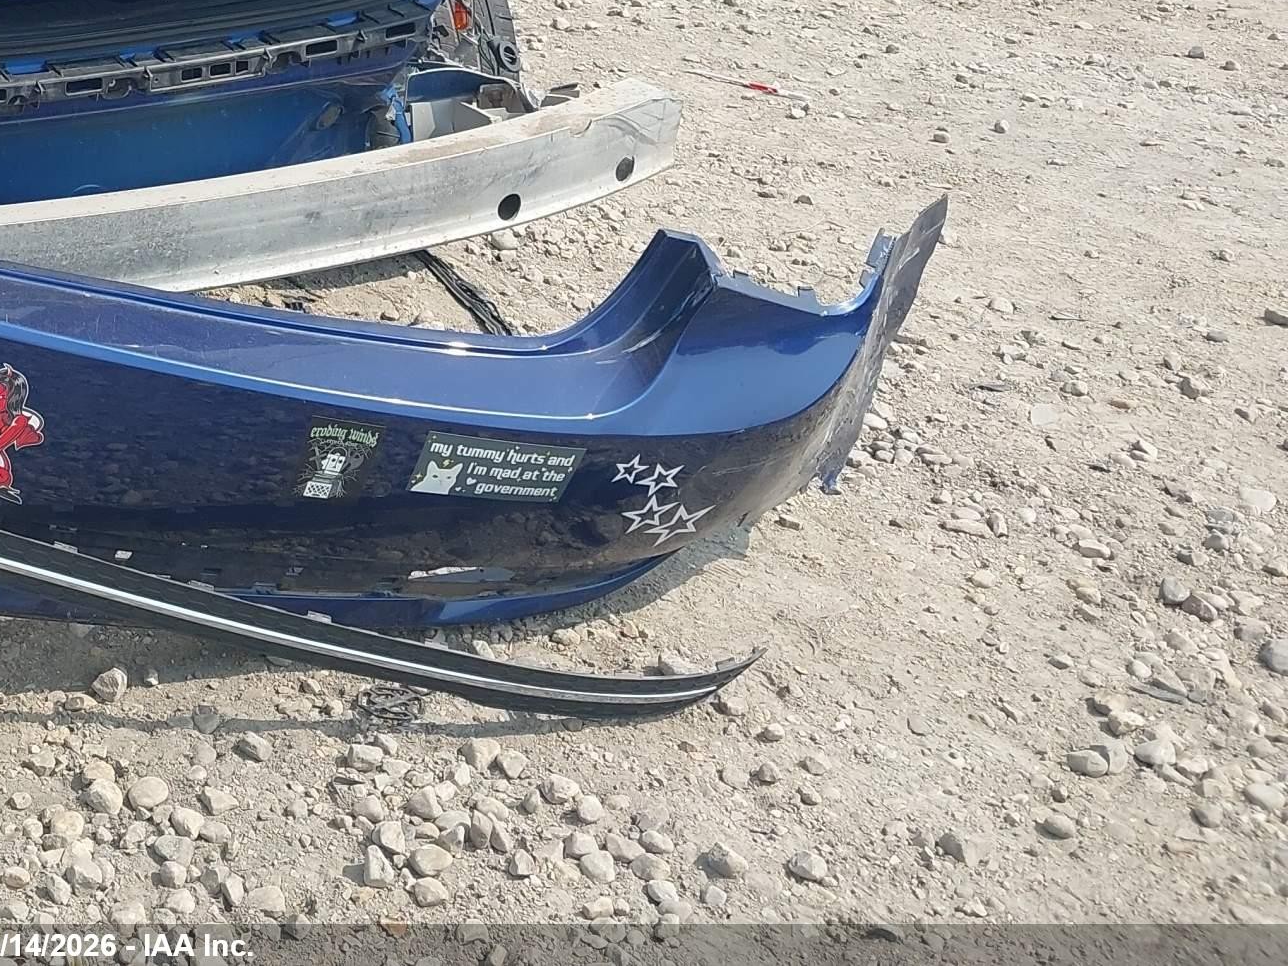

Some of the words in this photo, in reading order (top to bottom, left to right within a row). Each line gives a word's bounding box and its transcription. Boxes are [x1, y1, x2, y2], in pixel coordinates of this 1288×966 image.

[429, 441, 454, 459] my
[457, 444, 505, 464] tummy
[507, 447, 545, 465] hurts
[547, 453, 575, 468] and
[467, 462, 487, 477] I'm
[490, 465, 518, 480] mad
[522, 468, 539, 481] at
[542, 468, 564, 483] the
[474, 481, 558, 498] government
